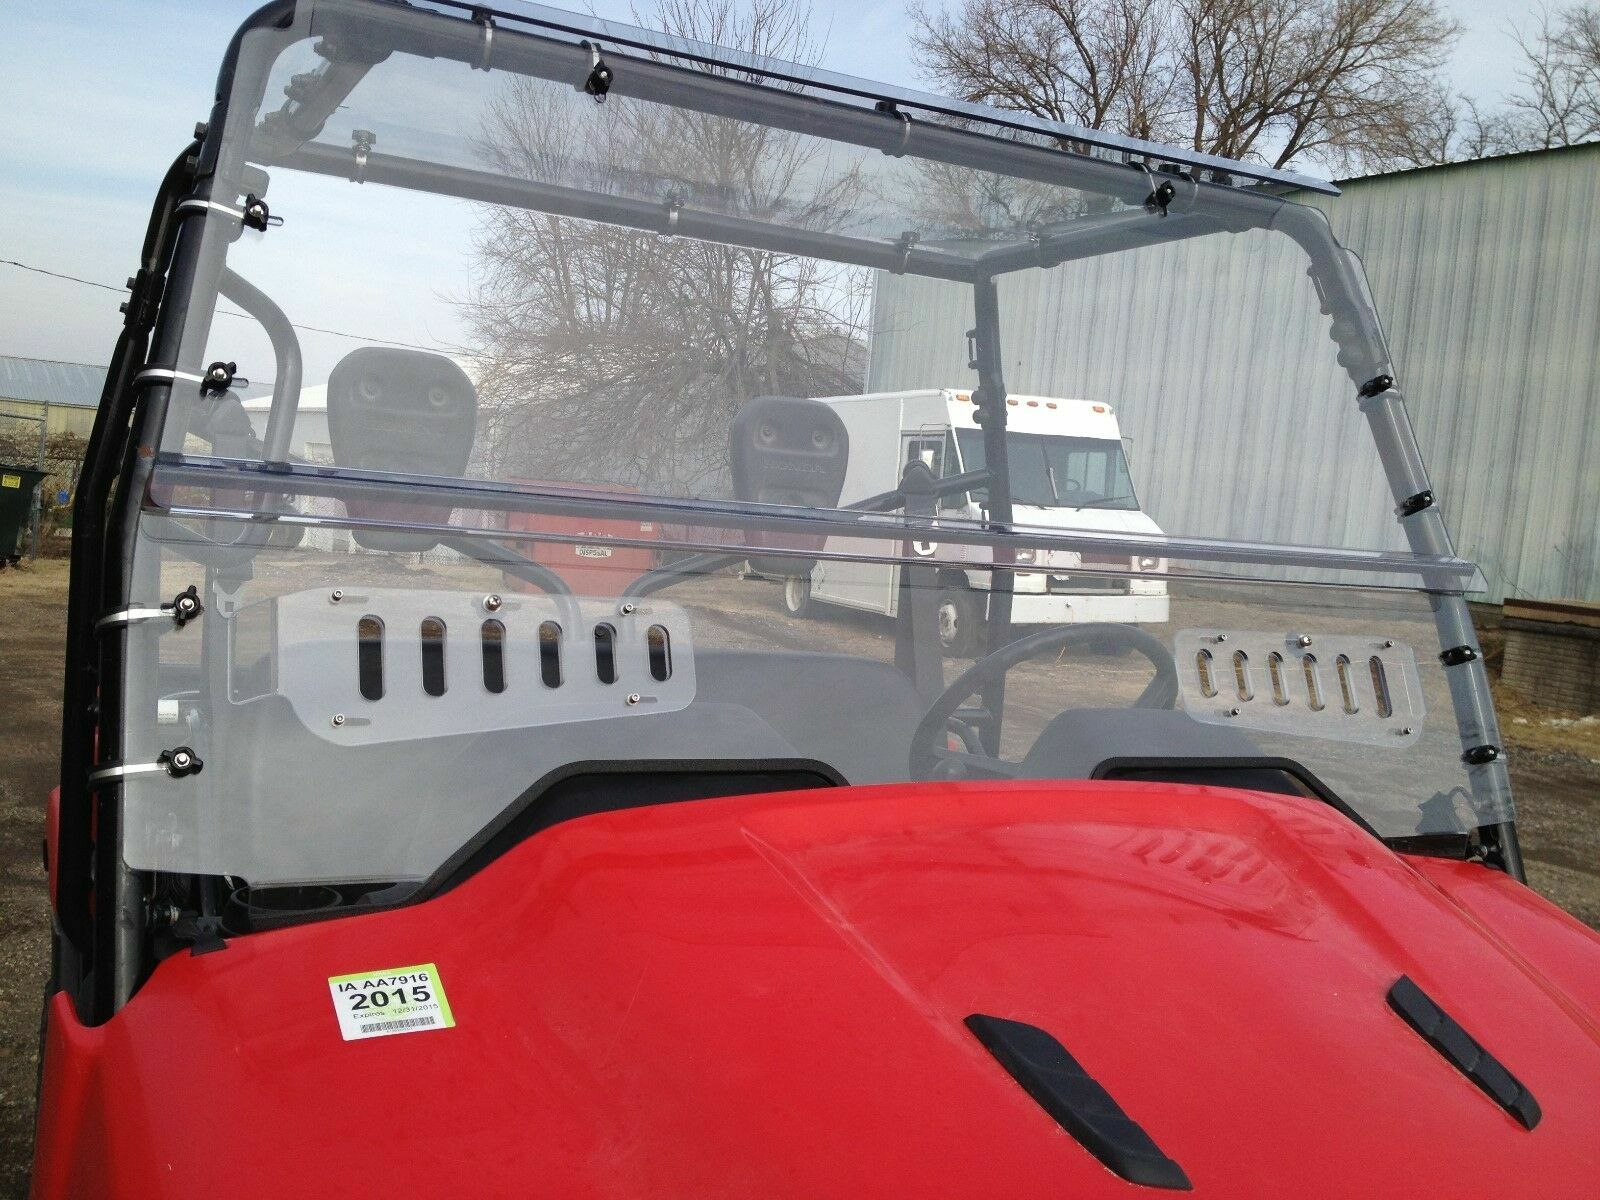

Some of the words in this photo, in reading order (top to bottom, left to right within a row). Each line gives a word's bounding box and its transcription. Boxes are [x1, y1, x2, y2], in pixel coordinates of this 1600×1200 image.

[338, 982, 357, 993] IA
[363, 973, 429, 990] AA7916
[349, 985, 431, 1011] 2015
[392, 1003, 439, 1014] 12/31/2015
